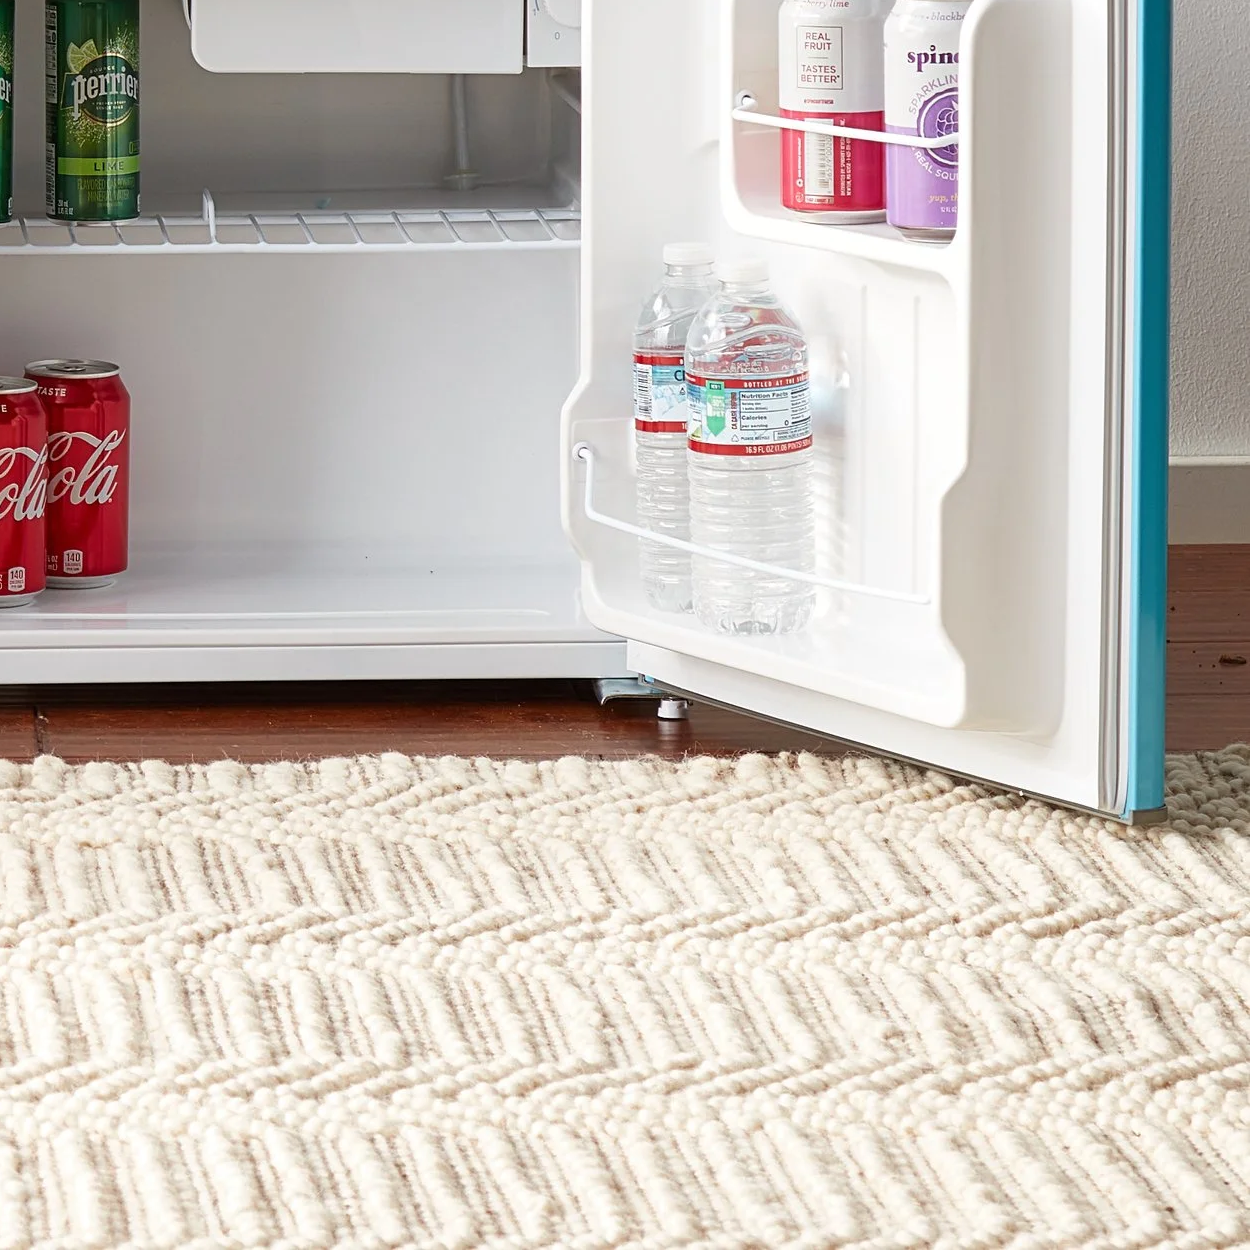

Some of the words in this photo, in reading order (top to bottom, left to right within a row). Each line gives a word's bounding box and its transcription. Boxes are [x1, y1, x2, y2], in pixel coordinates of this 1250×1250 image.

[805, 32, 831, 40] REAL
[804, 42, 832, 51] FRUIT
[801, 64, 837, 74] TASTES
[70, 65, 139, 121] perrier
[908, 73, 958, 115] SPARKLIN
[94, 161, 125, 172] LIME
[914, 150, 933, 174] REAL
[37, 386, 67, 397] TASTE
[66, 552, 81, 562] 140
[10, 569, 24, 580] 140
